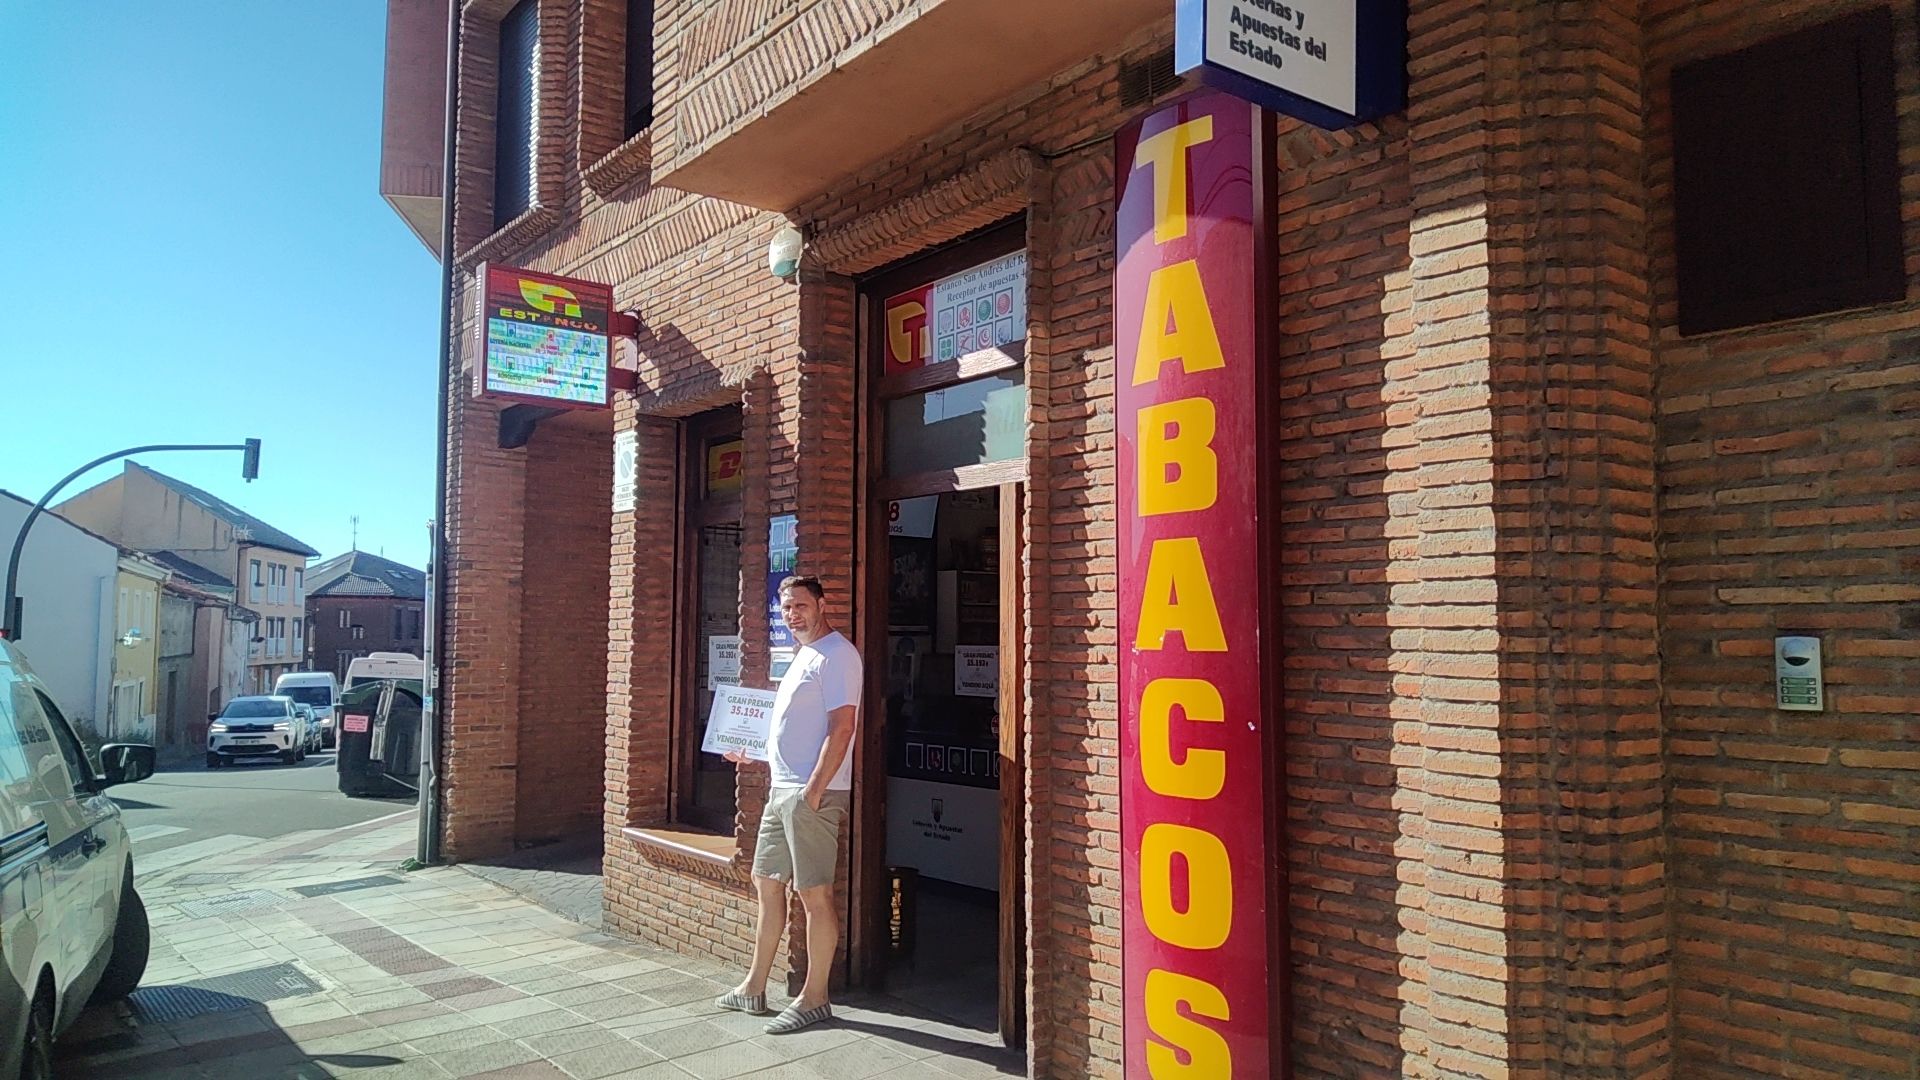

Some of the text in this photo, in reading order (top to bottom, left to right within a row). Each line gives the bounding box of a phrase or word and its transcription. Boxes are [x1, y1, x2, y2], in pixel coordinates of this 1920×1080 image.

[1230, 5, 1327, 62] Apuestas del
[1295, 10, 1305, 31] y
[1229, 31, 1283, 69] Estado
[936, 280, 962, 294] Estanco
[963, 274, 977, 285] San
[1004, 256, 1016, 269] del
[947, 285, 977, 303] Receptor
[978, 282, 987, 292] de
[988, 272, 1019, 291] apuestas
[1132, 115, 1234, 1080] TABACOS
[727, 695, 775, 709] GRAN PREMIO
[730, 705, 765, 719] 35.192€
[716, 733, 768, 750] VENDIDO AQUÍ
